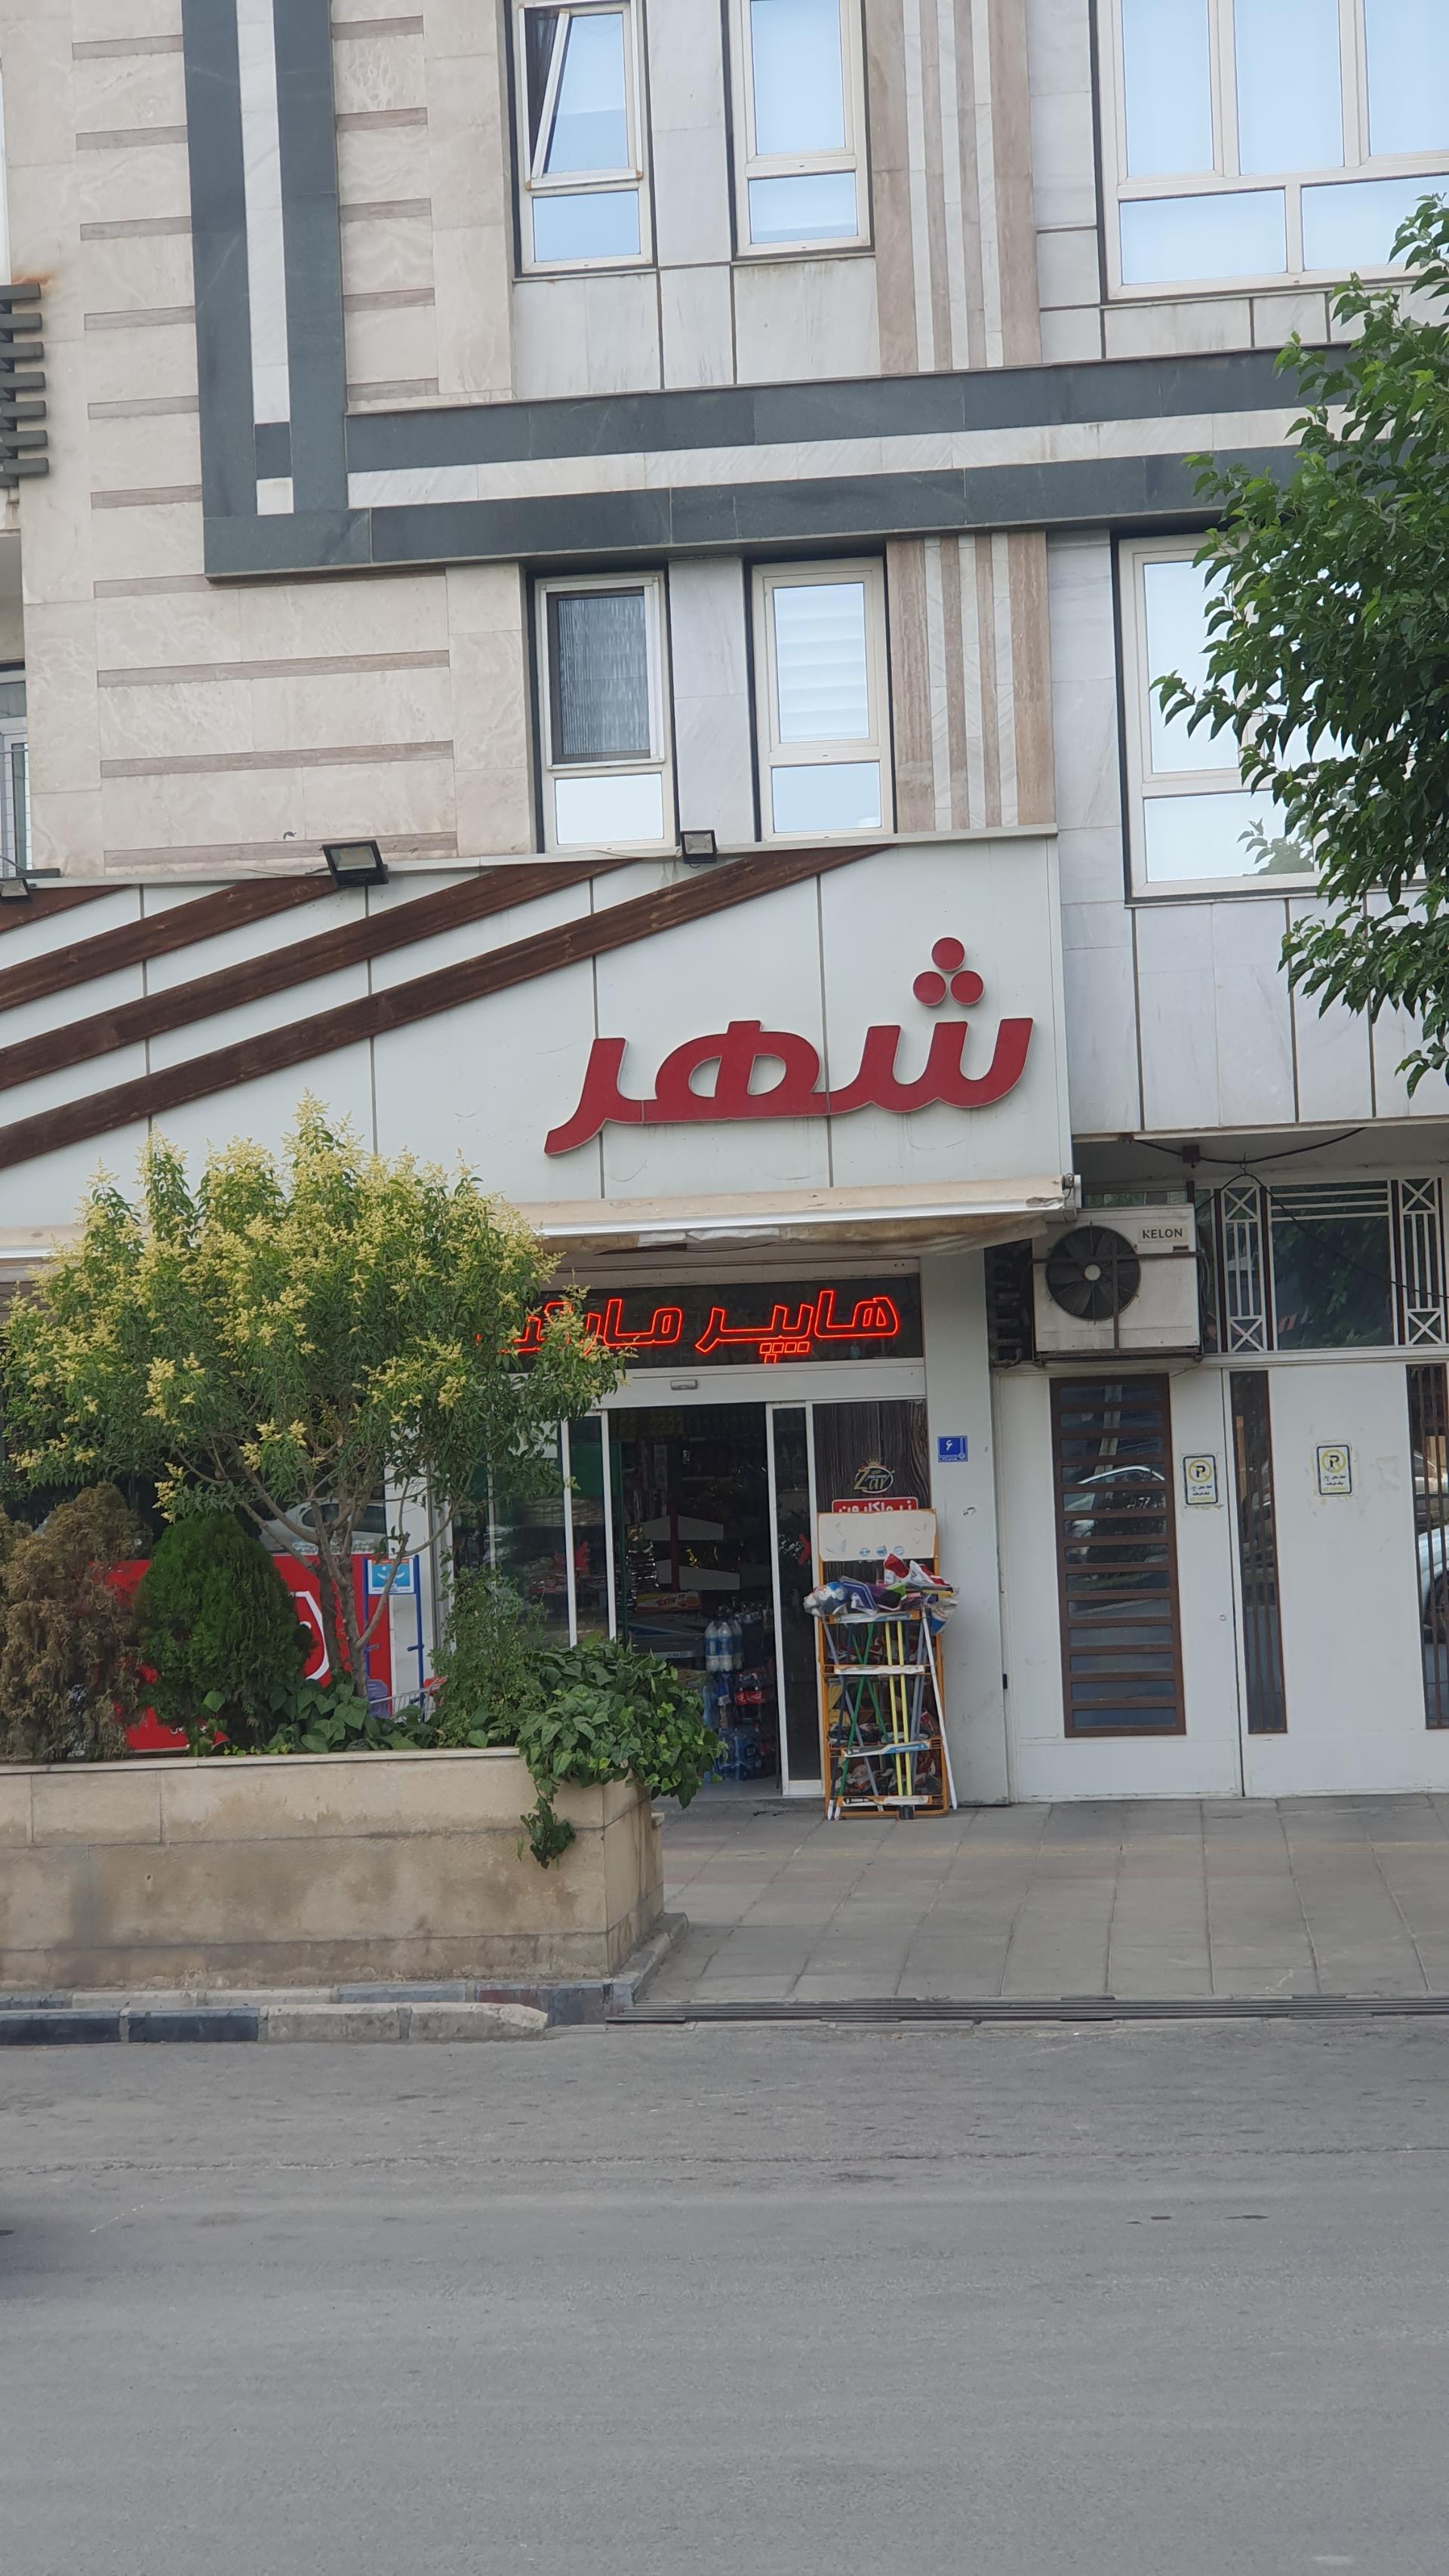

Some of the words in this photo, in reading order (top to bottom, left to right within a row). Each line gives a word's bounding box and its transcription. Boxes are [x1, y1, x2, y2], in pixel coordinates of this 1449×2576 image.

[544, 937, 1034, 1157] شهر
[1142, 1227, 1183, 1239] KELON
[695, 1291, 898, 1364] هایپر
[854, 1469, 895, 1491] Zar
